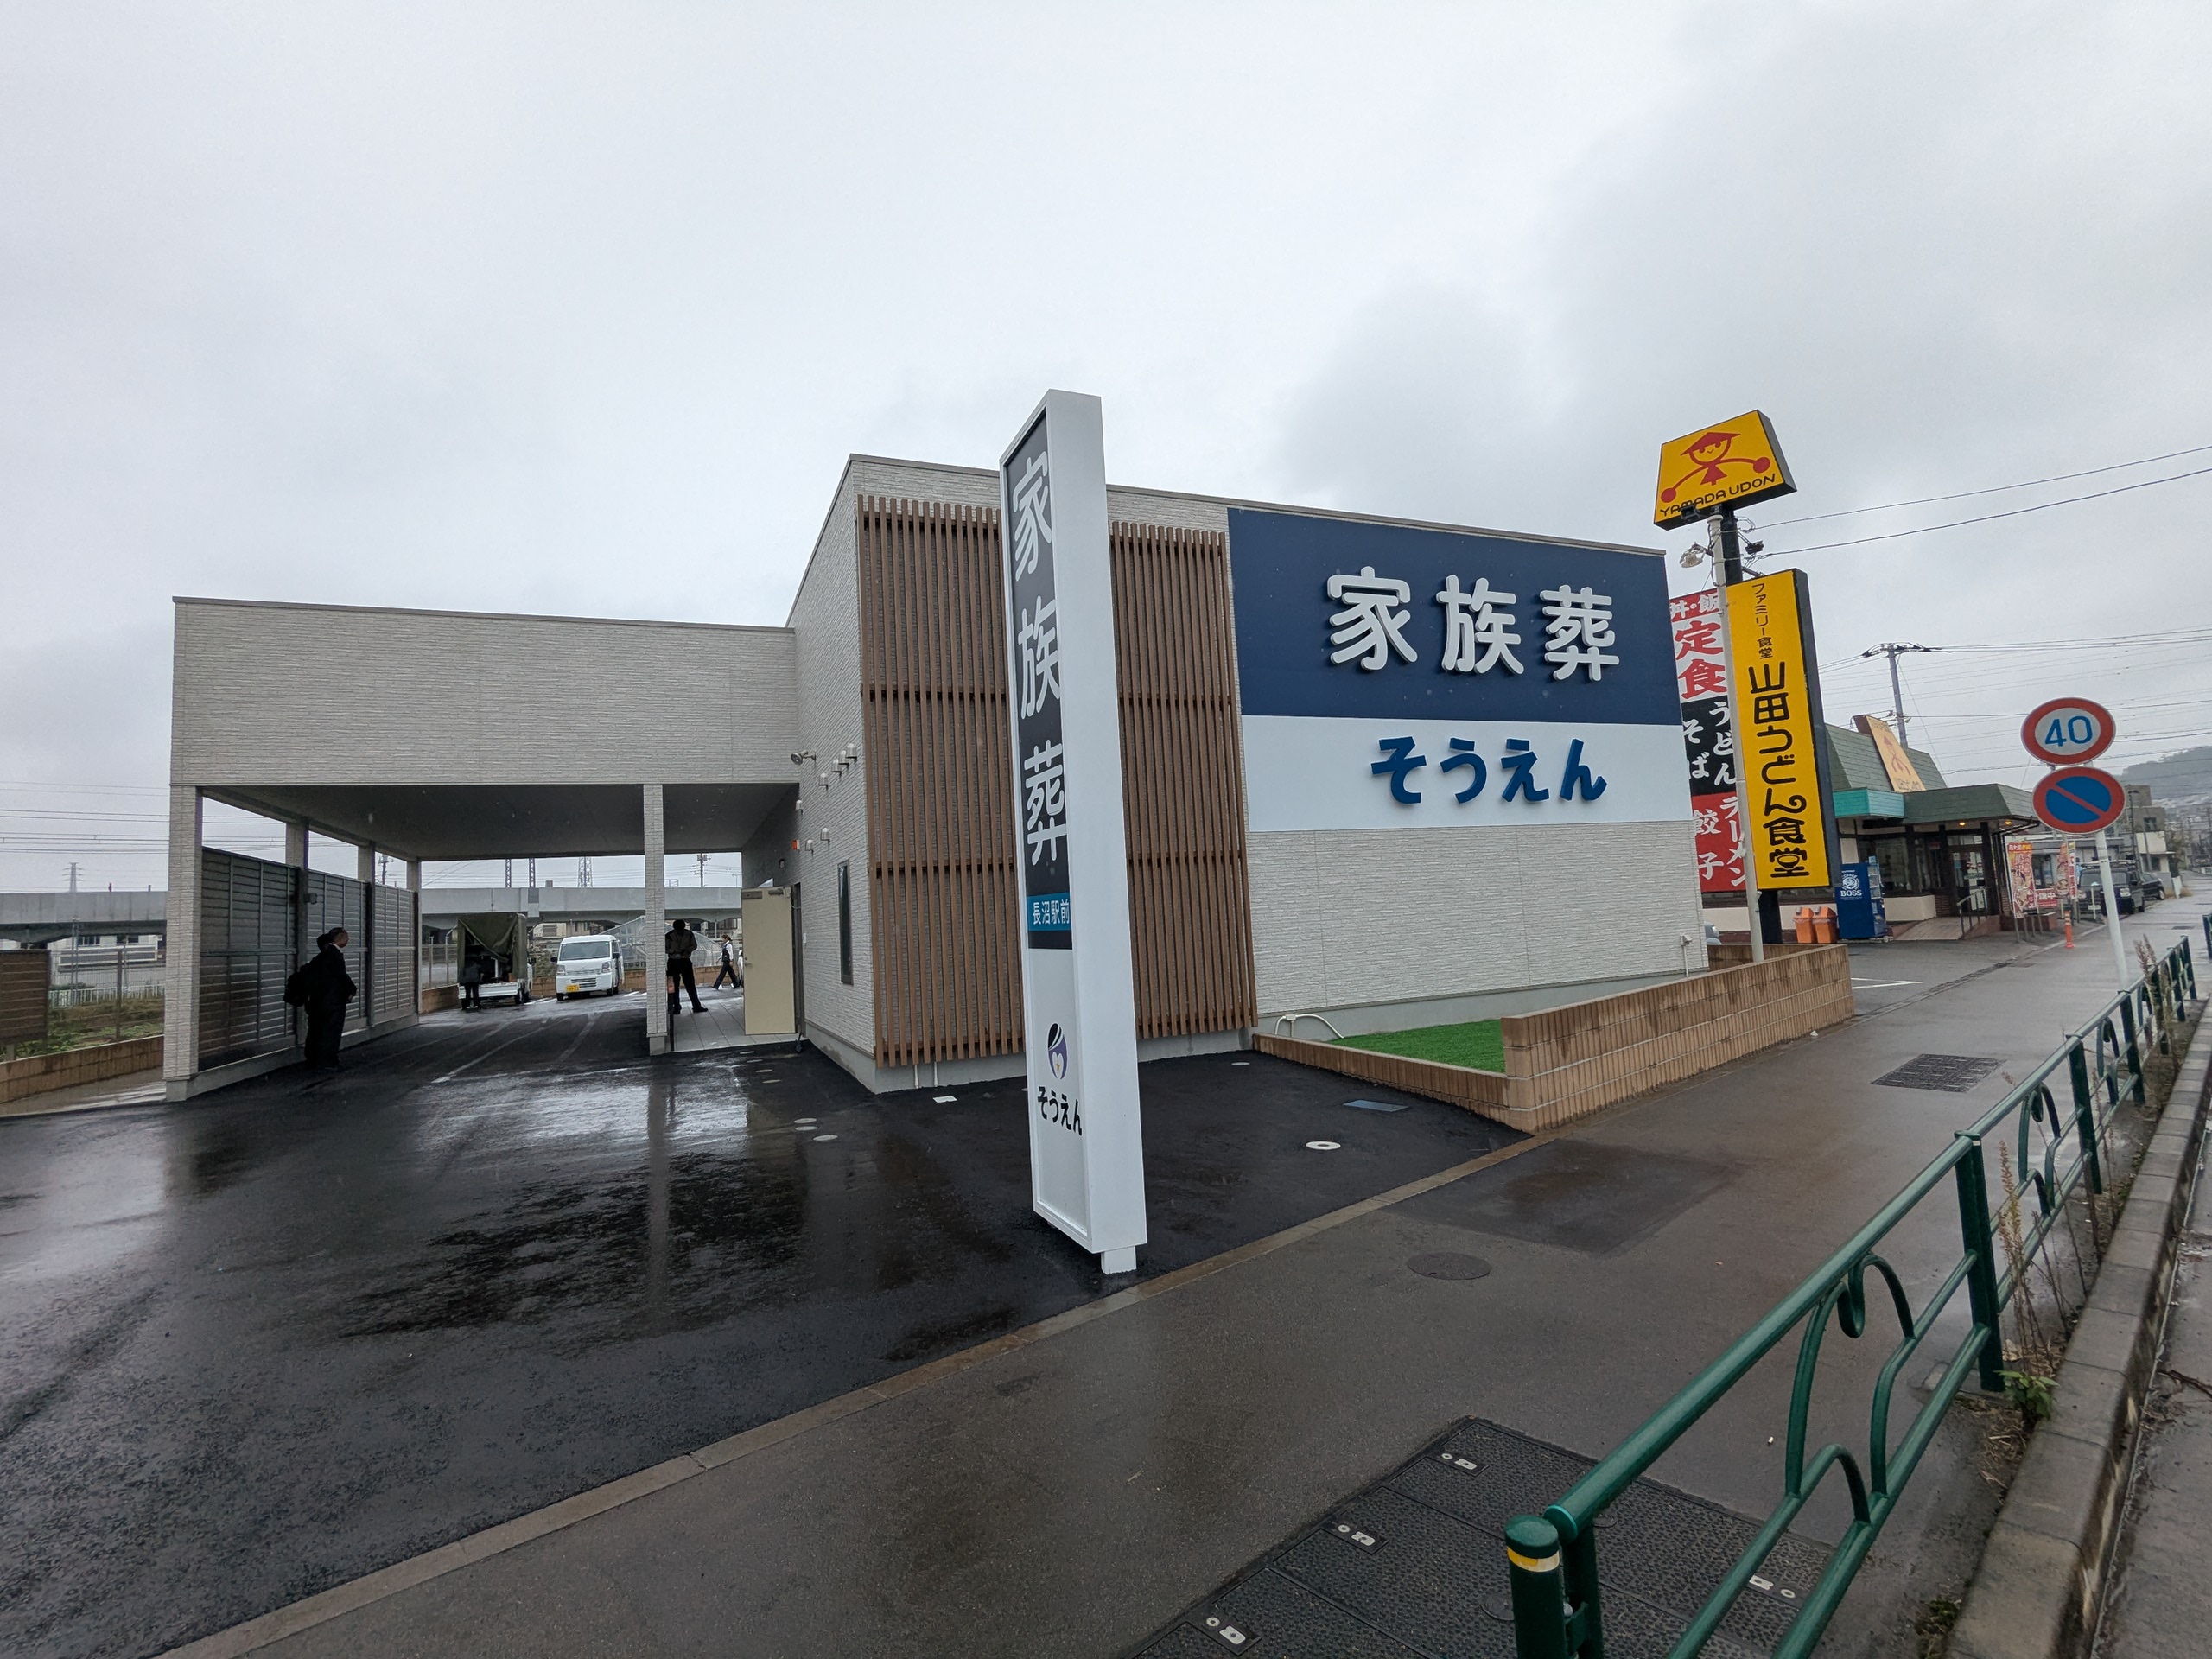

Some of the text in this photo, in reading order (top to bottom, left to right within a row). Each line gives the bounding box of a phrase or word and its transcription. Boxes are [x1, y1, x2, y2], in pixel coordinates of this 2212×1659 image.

[1728, 473, 1777, 495] UDON
[1012, 450, 1068, 866] 家族葬
[1327, 565, 1620, 683] 家族葬
[1751, 582, 1774, 660] ファミリー食堂
[1674, 620, 1727, 699] 定食
[1682, 718, 1710, 779] そば
[1709, 701, 1737, 786] うどん
[2044, 715, 2093, 747] 40
[1370, 735, 1608, 804] そうえん
[1748, 660, 1810, 879] 山田うどん食堂
[1693, 808, 1725, 880] 餃子
[1719, 796, 1745, 887] ラーメン
[1033, 899, 1070, 925] 長沼駅前
[1037, 1085, 1083, 1136] そうえん
